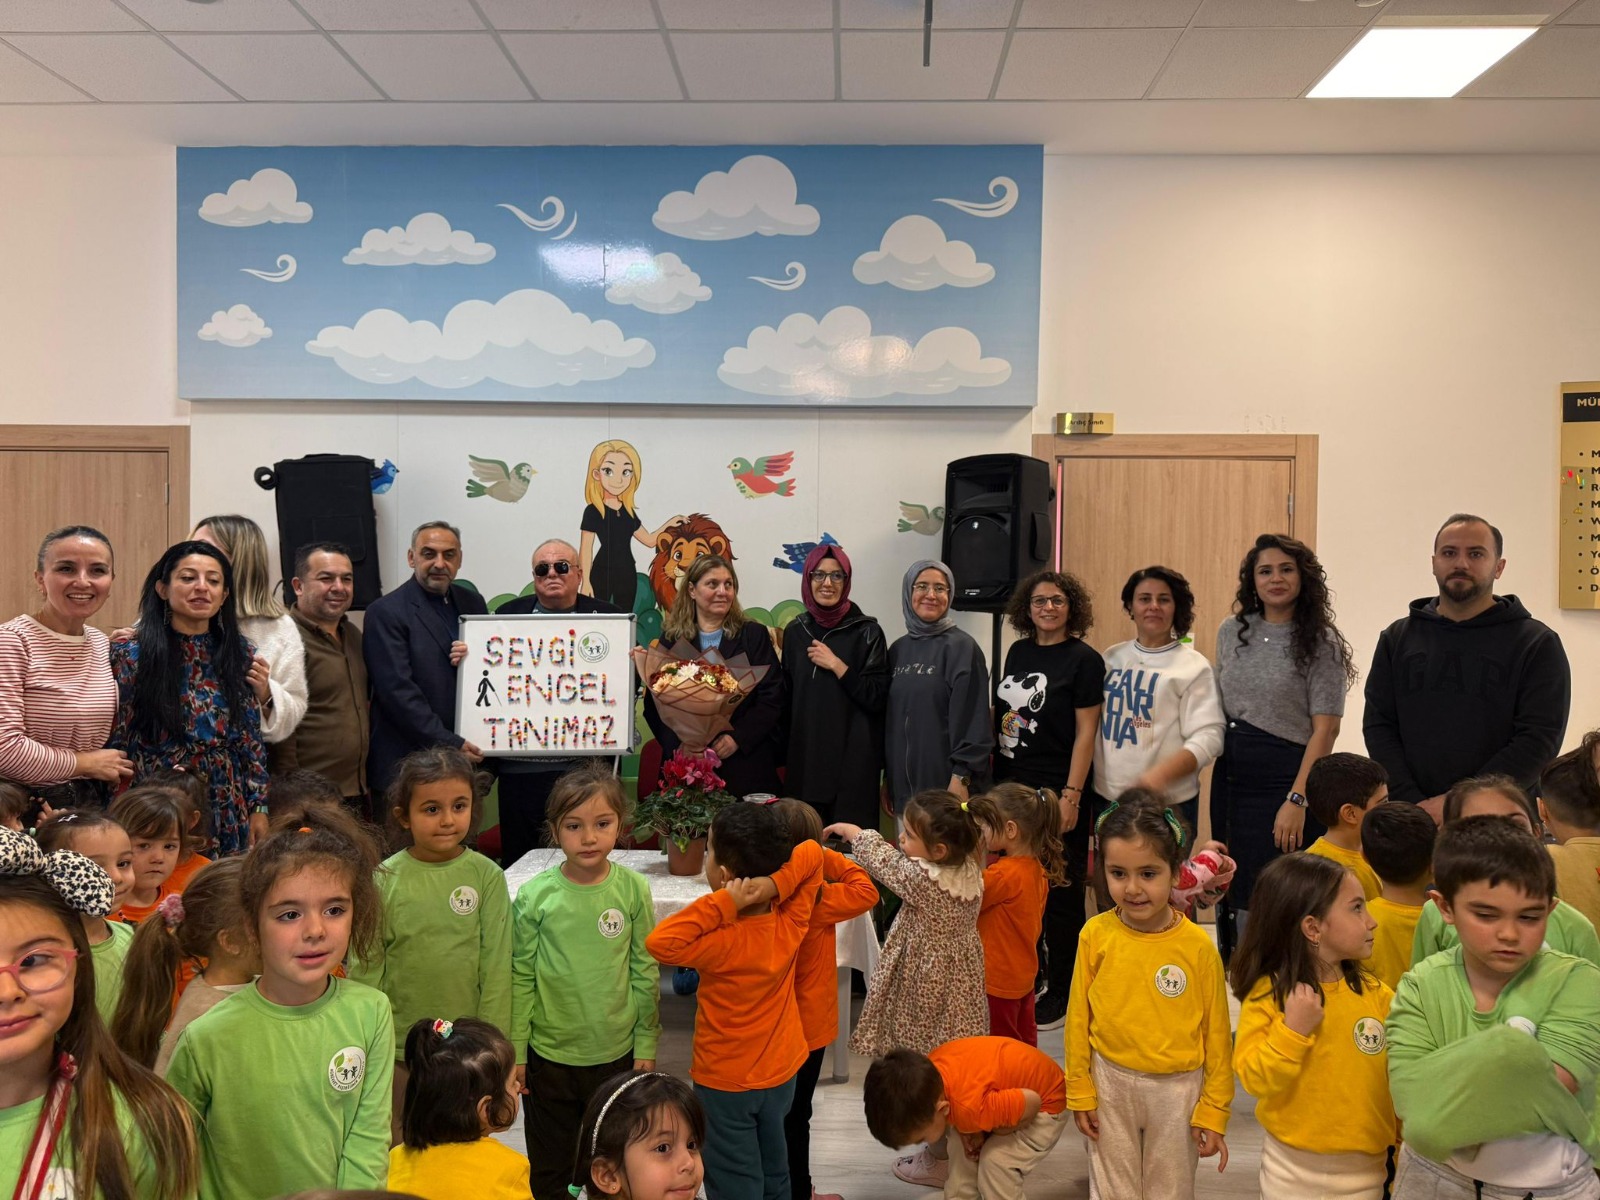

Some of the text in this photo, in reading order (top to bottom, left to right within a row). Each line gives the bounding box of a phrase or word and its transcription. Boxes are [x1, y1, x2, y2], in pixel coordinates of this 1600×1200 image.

[483, 629, 576, 667] SEVGİ
[507, 672, 616, 705] ENGEL
[1402, 651, 1506, 696] GAP
[483, 715, 617, 750] TANIMAZ
